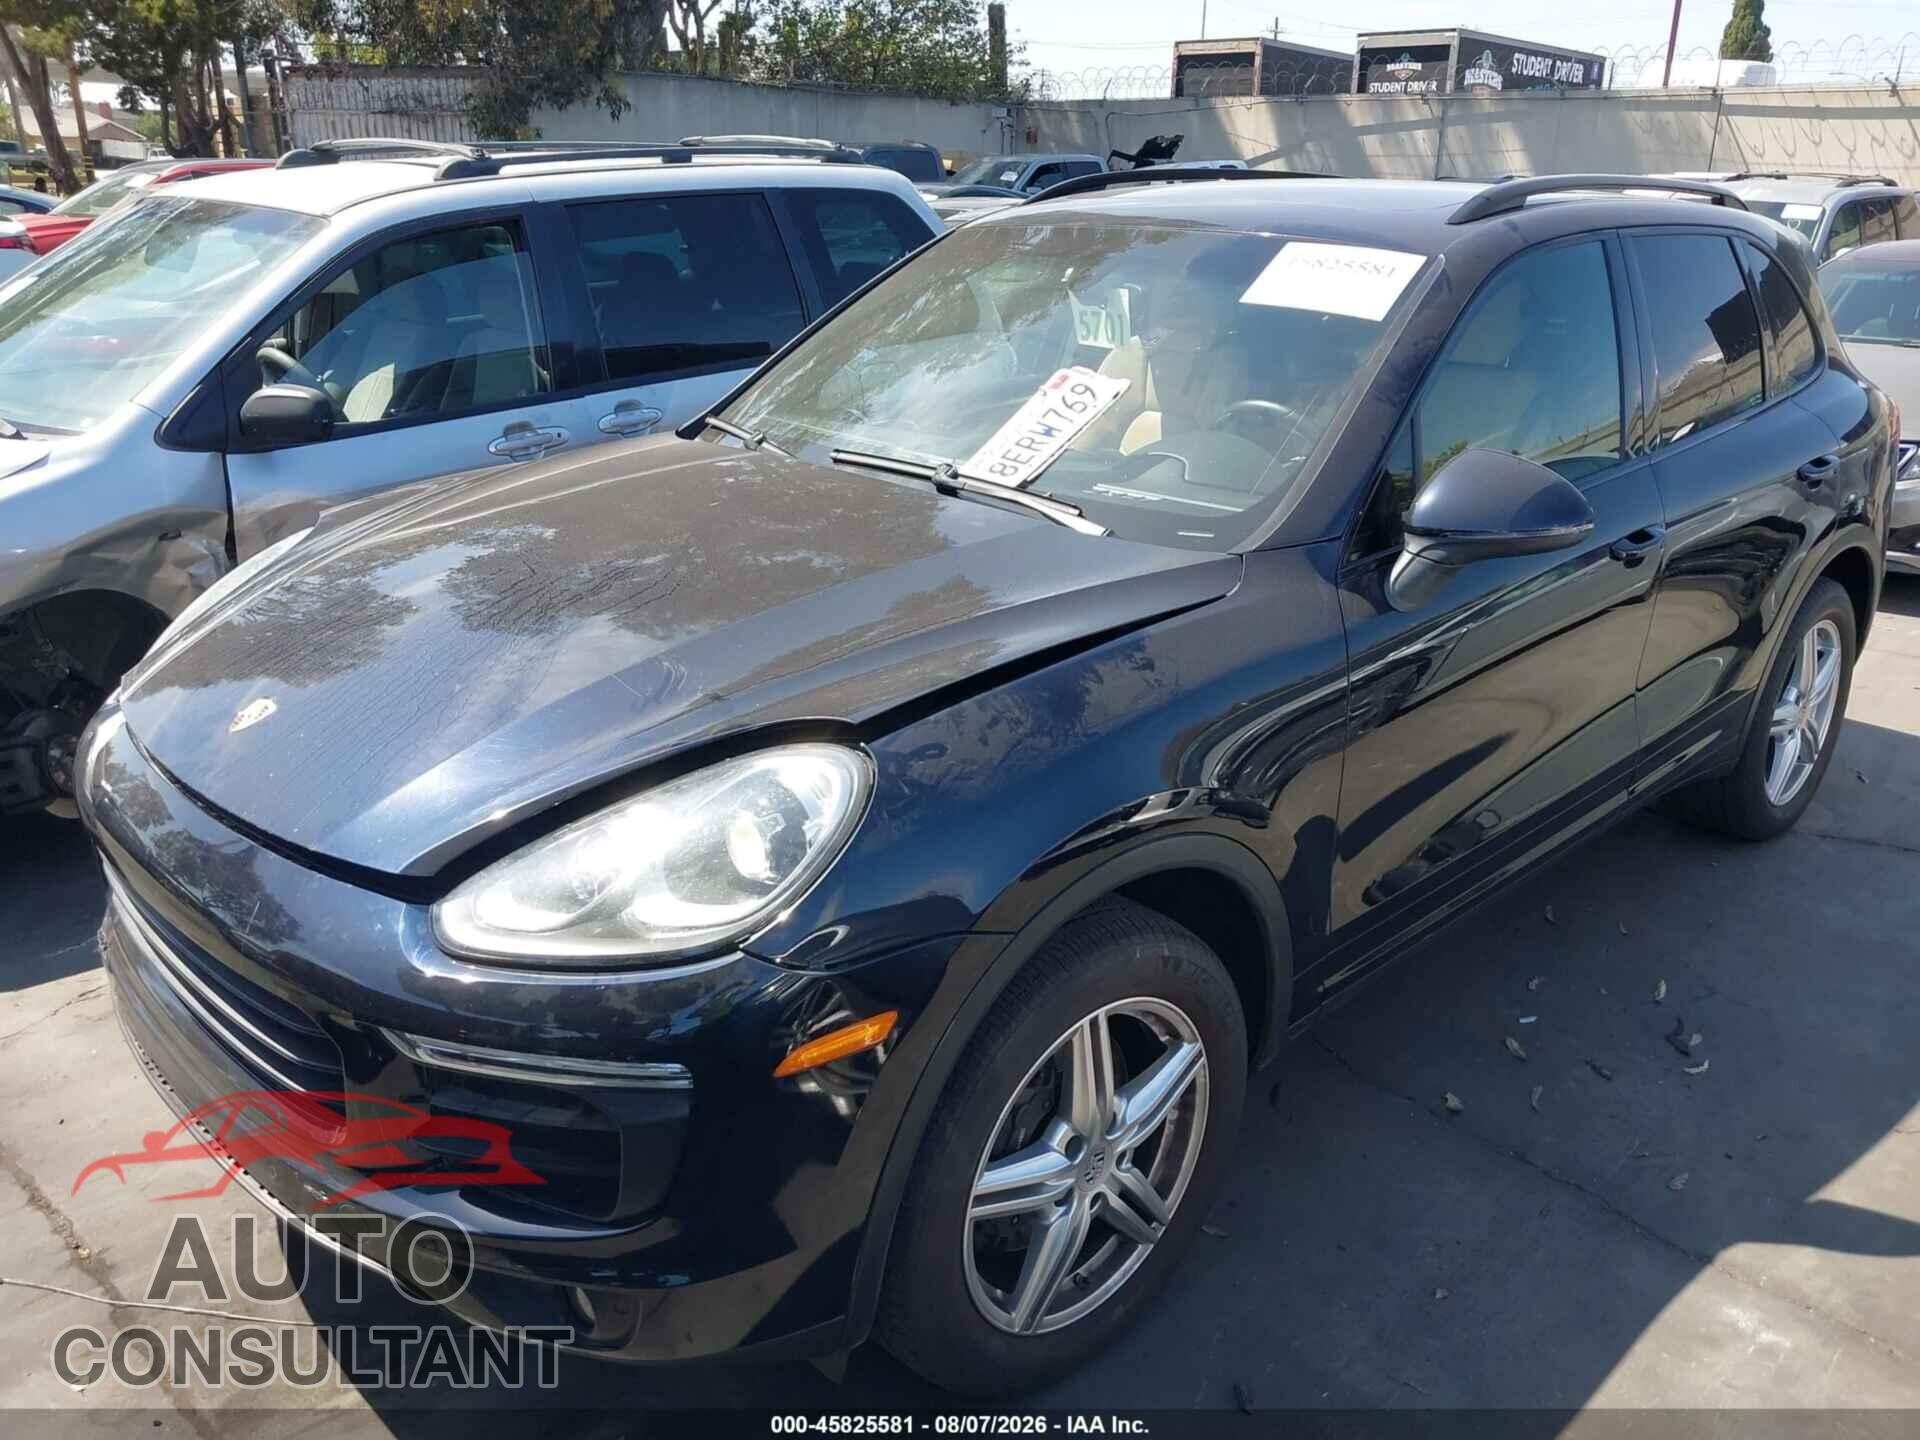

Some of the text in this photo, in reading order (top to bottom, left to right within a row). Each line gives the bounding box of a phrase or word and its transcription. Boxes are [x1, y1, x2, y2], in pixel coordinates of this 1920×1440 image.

[1512, 52, 1553, 78] STUDENT
[1555, 60, 1585, 84] DRIVER
[1369, 81, 1406, 93] STUDENT
[988, 383, 1097, 478] 8ERW769
